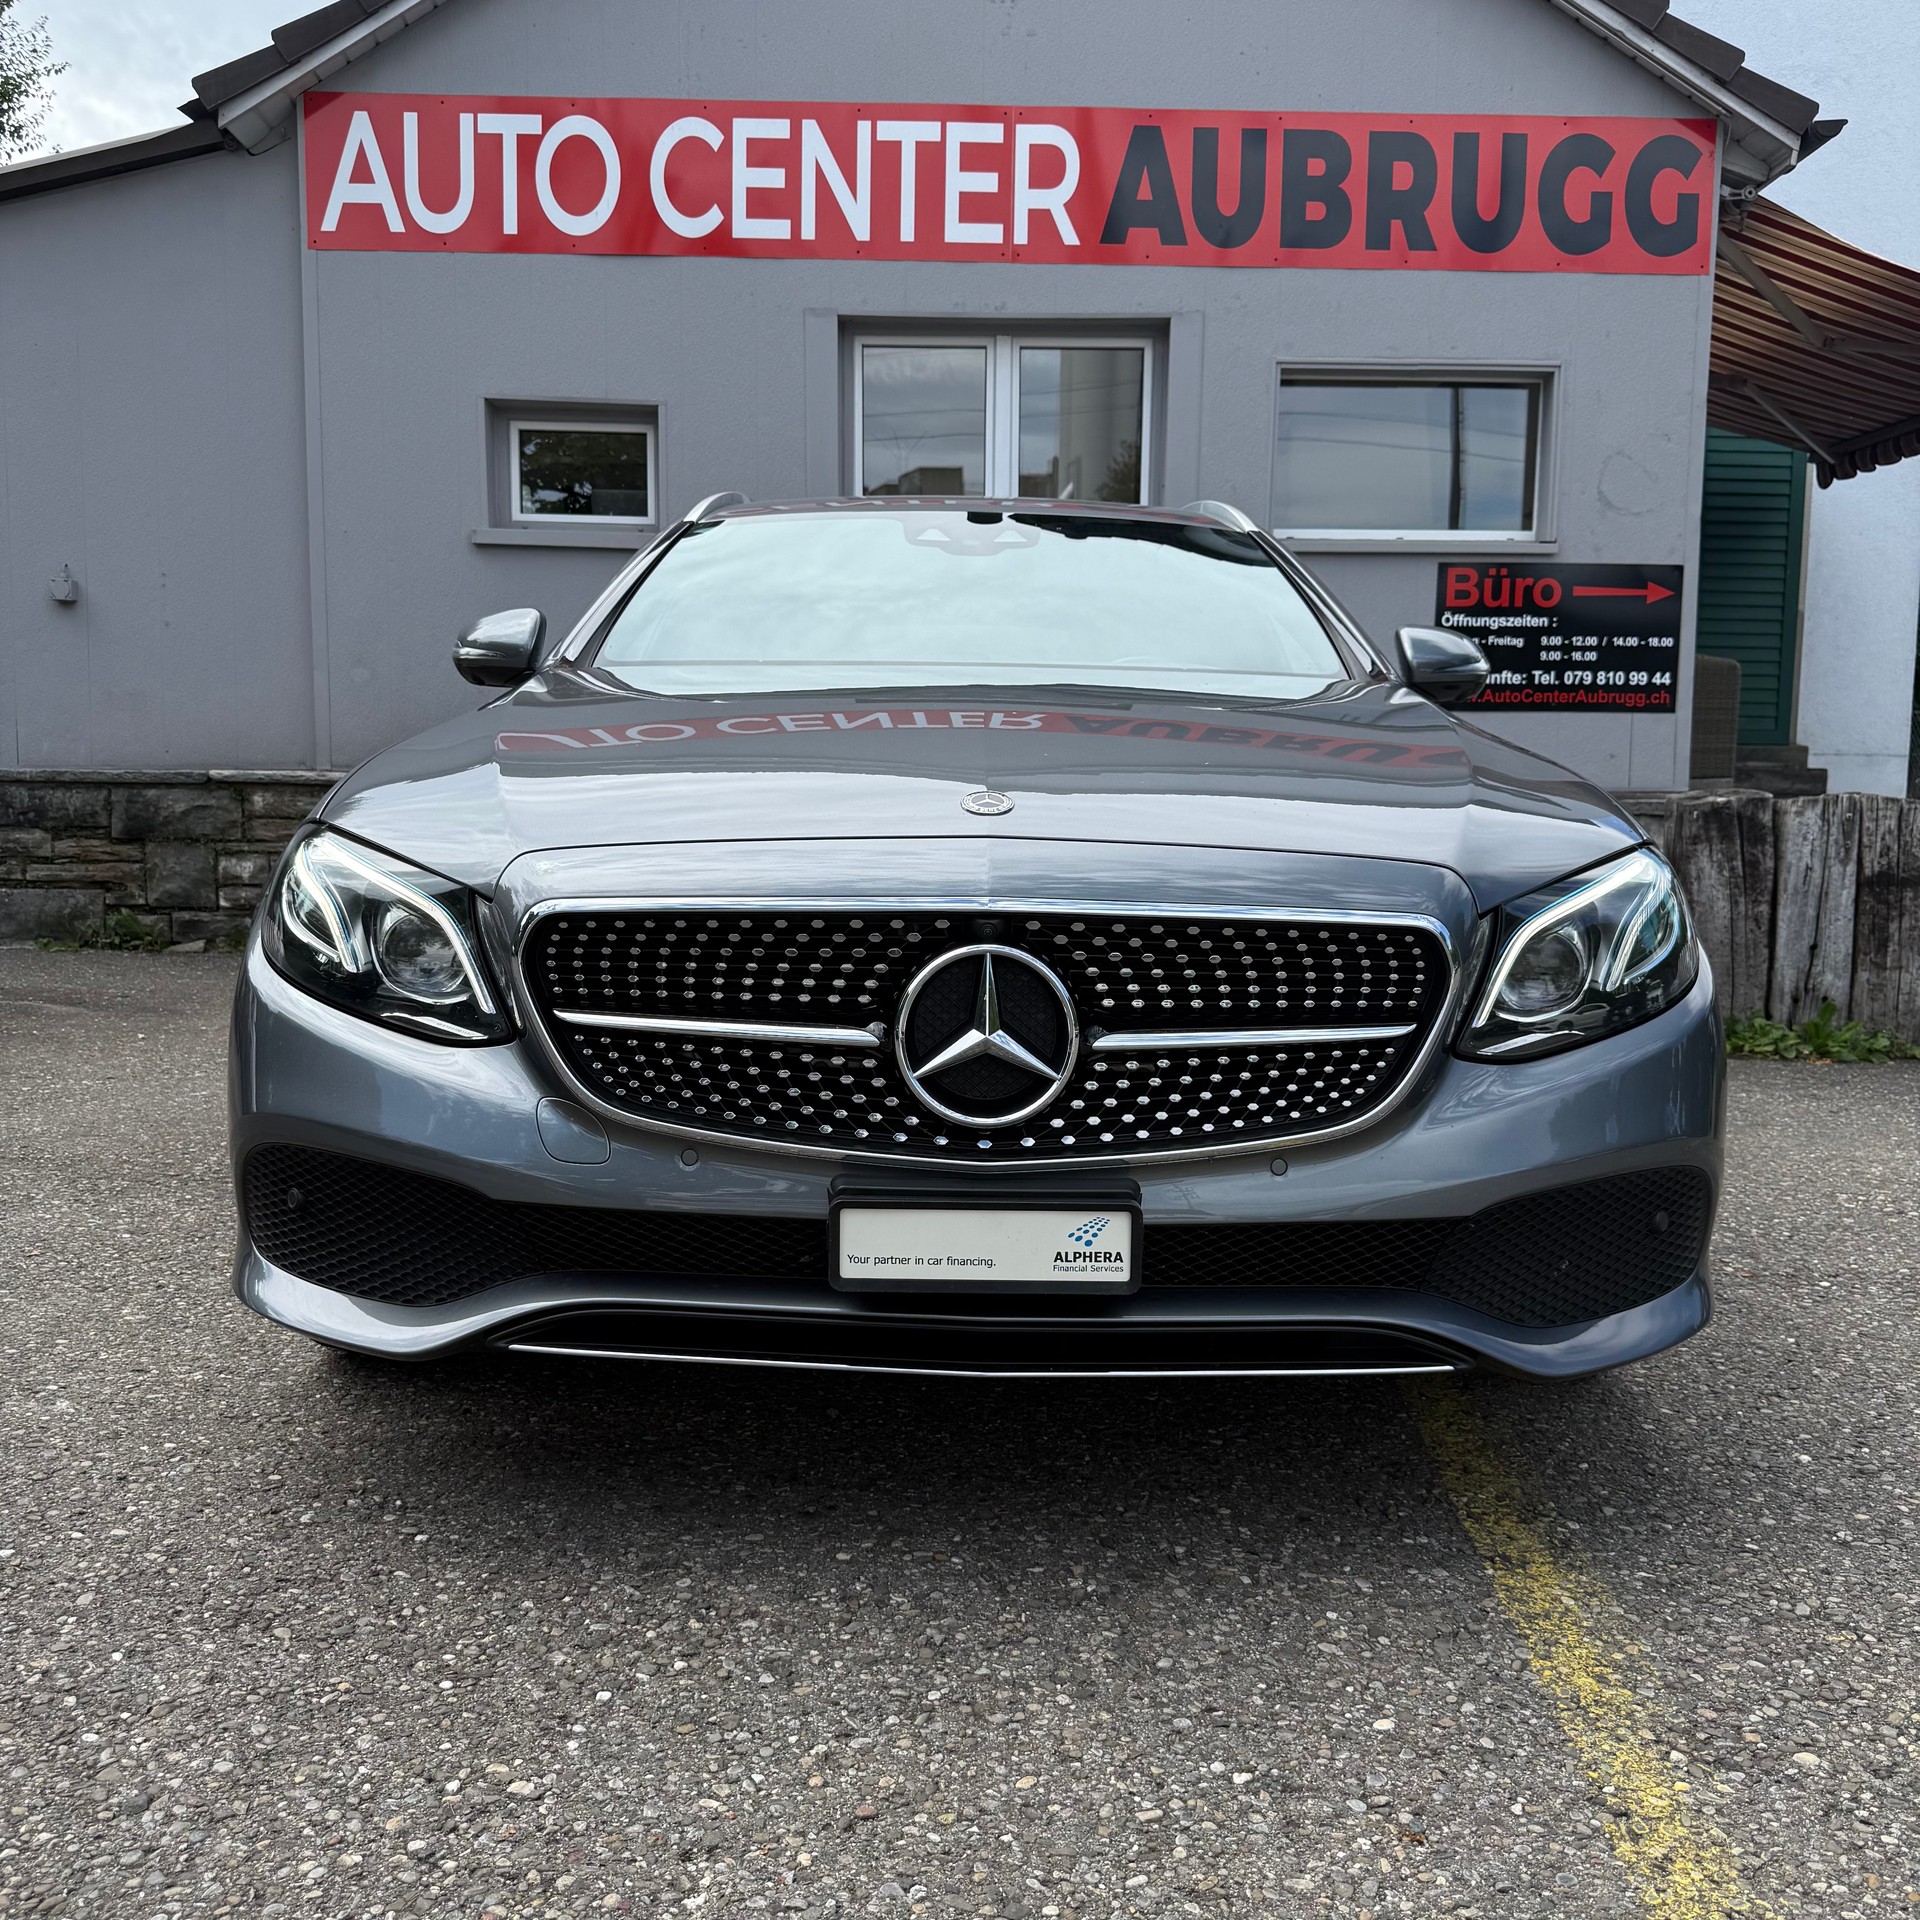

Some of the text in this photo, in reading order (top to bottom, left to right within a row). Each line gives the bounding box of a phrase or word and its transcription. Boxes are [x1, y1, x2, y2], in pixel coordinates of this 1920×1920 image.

[320, 110, 1703, 258] AUTO CENTER AUBRUGG
[1445, 567, 1563, 609] Büro
[1441, 611, 1549, 630] Öffnungszeiten
[1487, 635, 1524, 649] Freitag
[1540, 635, 1562, 647] 9.00
[1571, 636, 1598, 647] 12.00
[1612, 636, 1639, 648] 14.00
[1647, 637, 1674, 648] 18.00
[1540, 650, 1562, 662] 9.00
[1571, 651, 1598, 662] 16.00
[1531, 670, 1560, 685] Tel.
[1563, 670, 1593, 686] 079
[1596, 671, 1625, 686] 810
[1628, 671, 1649, 687] 99
[1651, 671, 1672, 687] 44
[847, 1254, 997, 1269] Your partner in car financing.
[1053, 1251, 1124, 1263] ALPHERA
[1053, 1264, 1124, 1273] Financial Services
